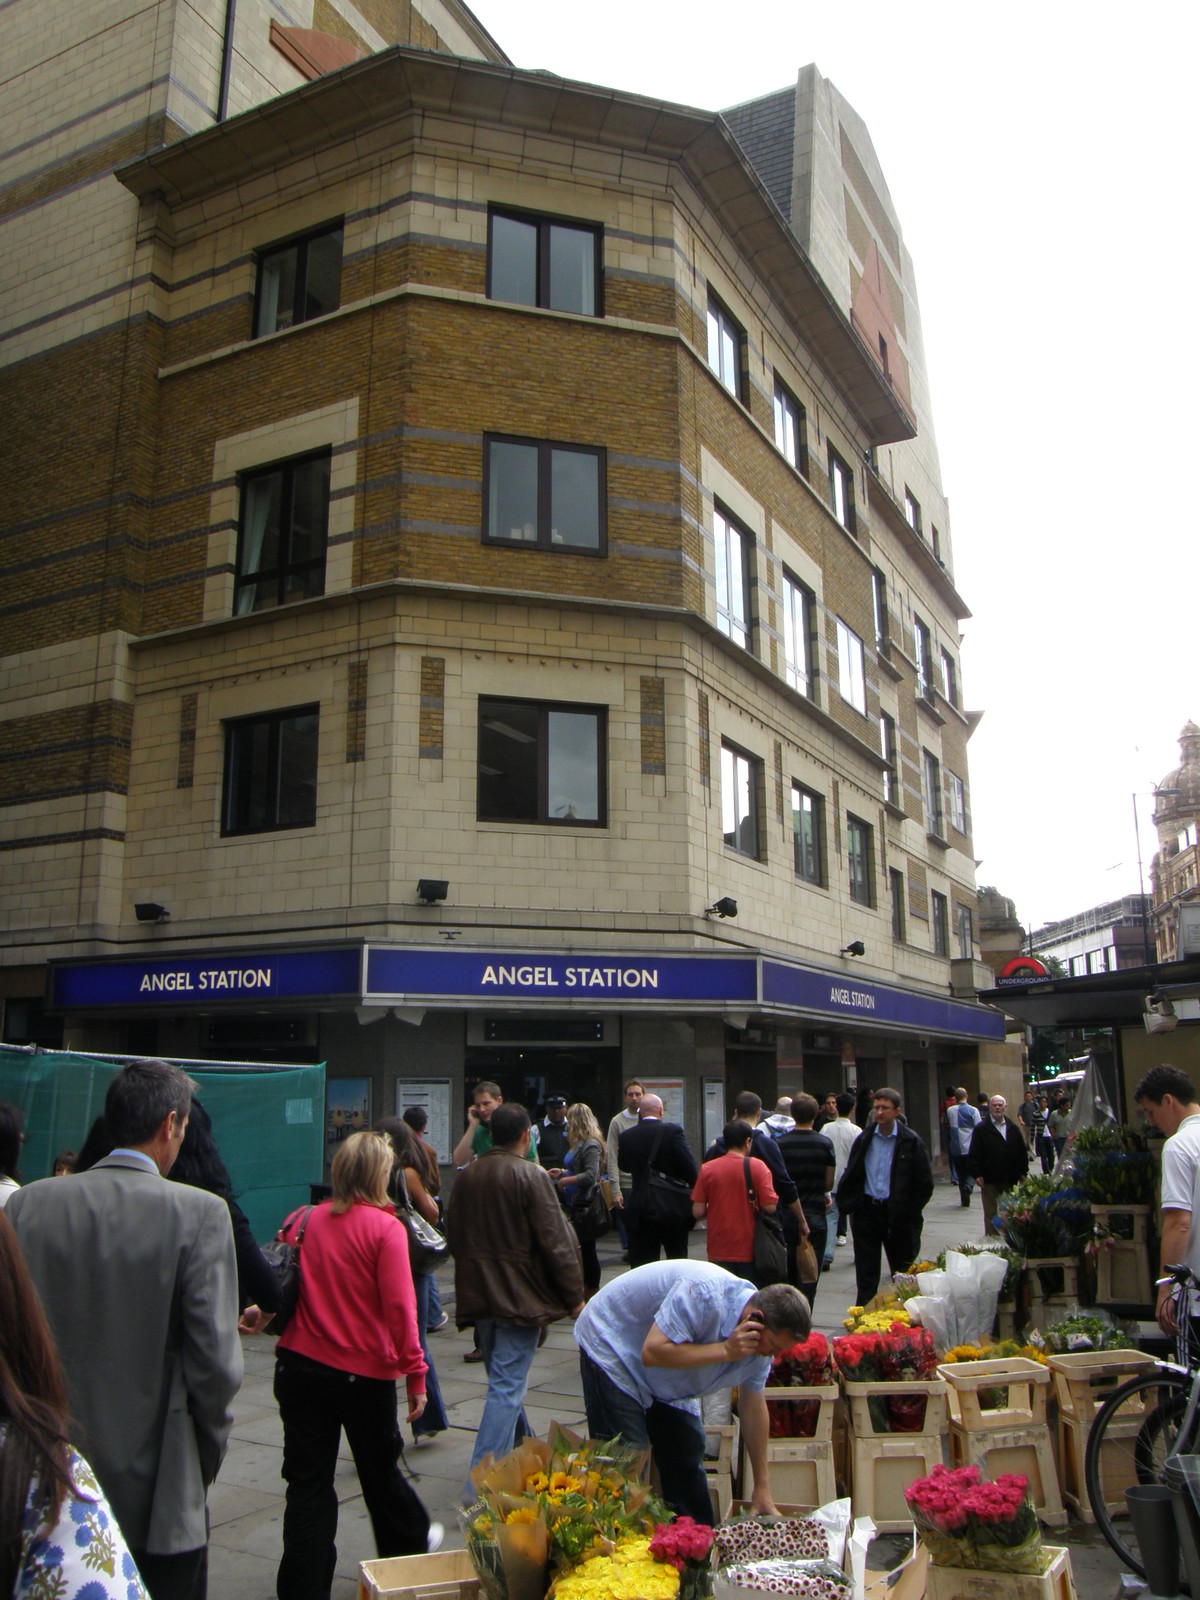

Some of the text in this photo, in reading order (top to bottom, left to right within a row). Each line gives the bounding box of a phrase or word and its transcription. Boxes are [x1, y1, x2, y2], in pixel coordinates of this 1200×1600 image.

[140, 968, 271, 991] ANGEL STATION
[481, 965, 658, 988] ANGEL STATION
[998, 976, 1049, 985] UNDERGROUND
[830, 987, 875, 1010] ANGEL STATION
